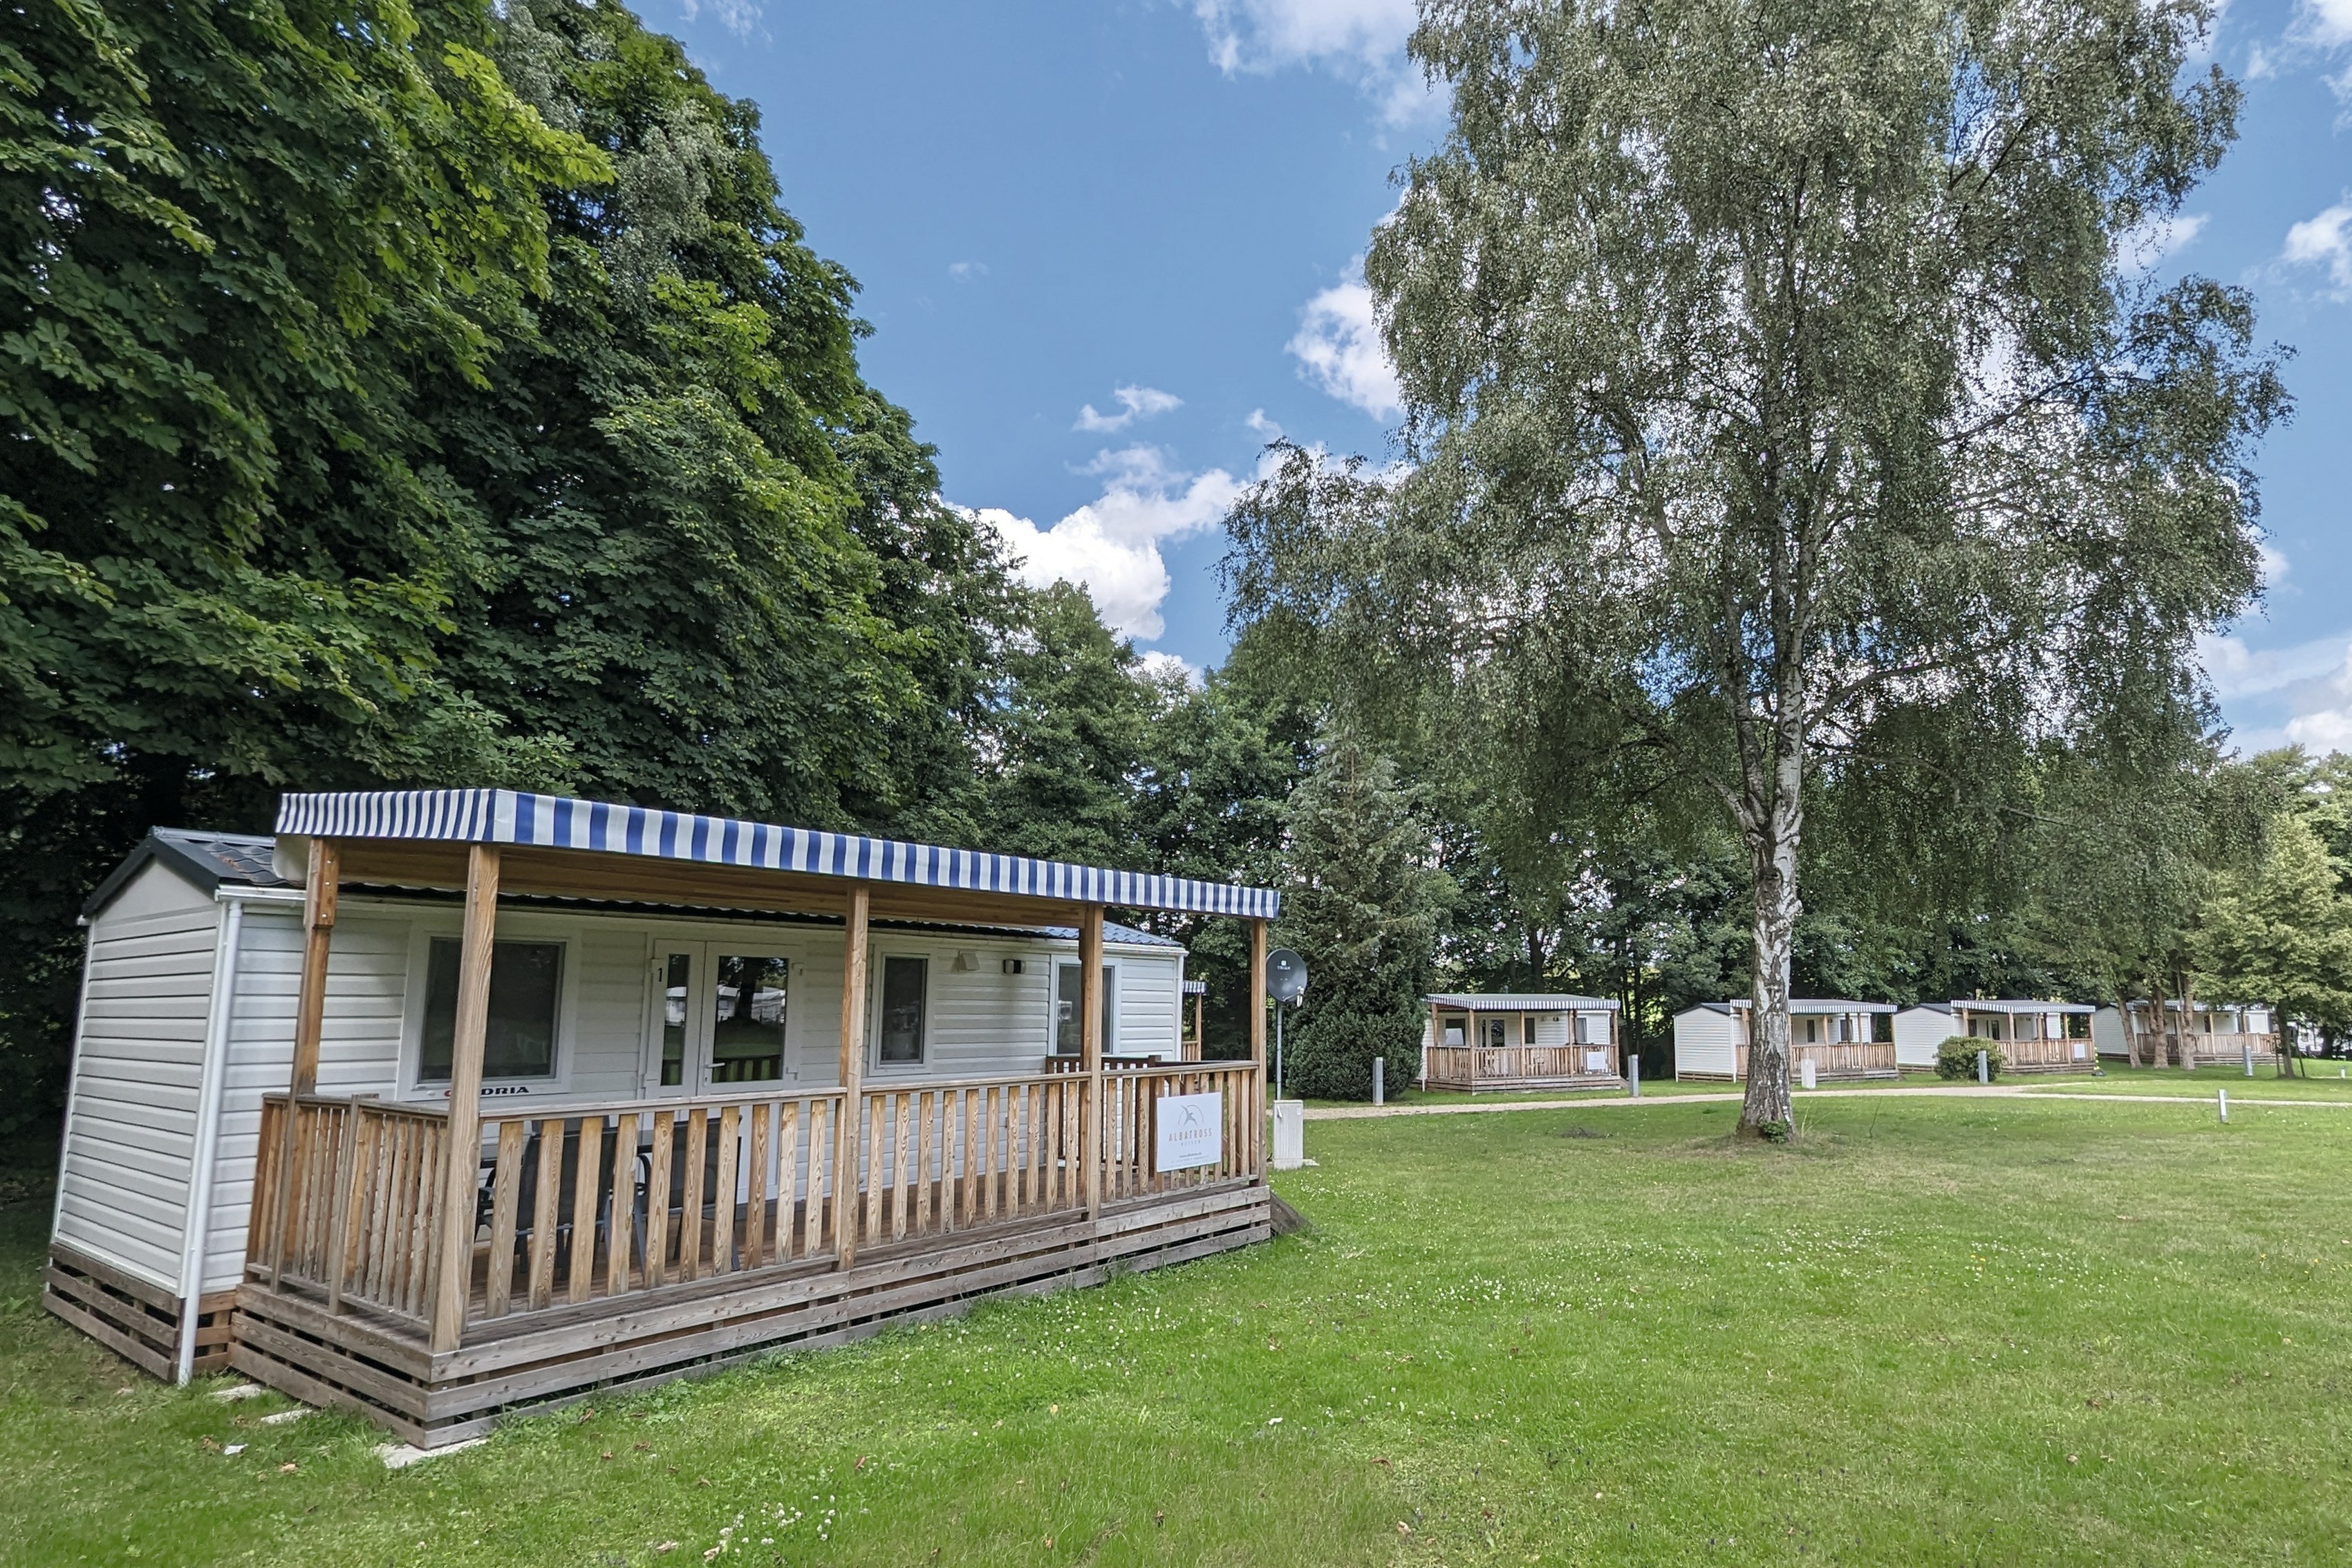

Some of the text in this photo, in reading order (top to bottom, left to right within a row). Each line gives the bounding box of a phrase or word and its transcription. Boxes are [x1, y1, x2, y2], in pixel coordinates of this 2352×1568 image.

[658, 967, 663, 982] 1
[480, 1086, 530, 1095] DRIA
[1168, 1128, 1212, 1142] ALBATROSS
